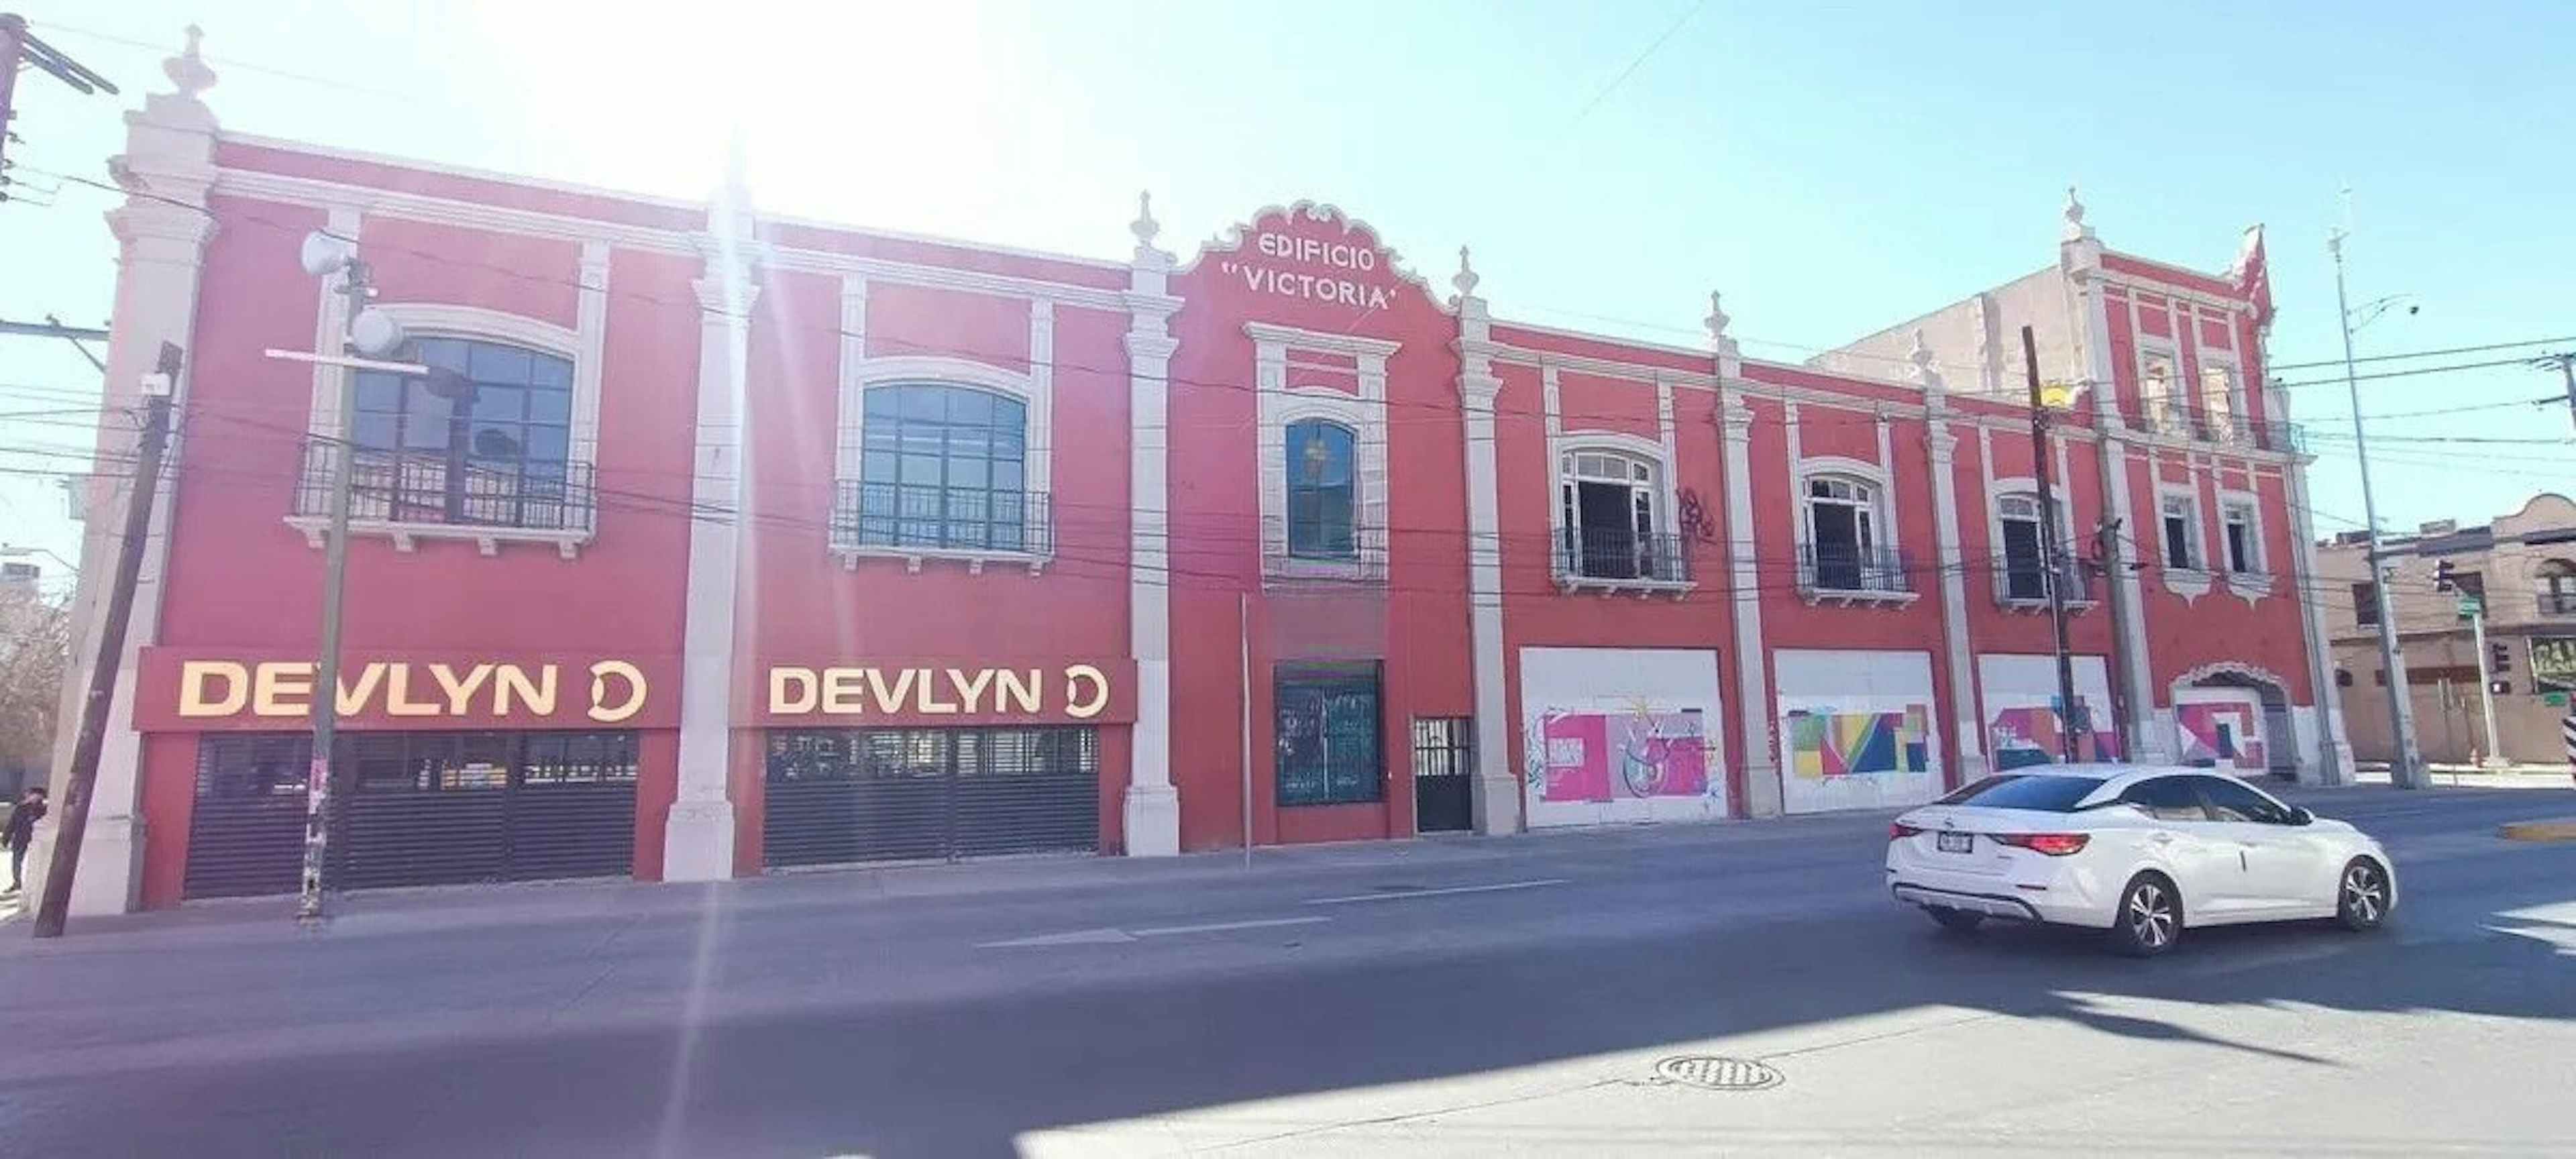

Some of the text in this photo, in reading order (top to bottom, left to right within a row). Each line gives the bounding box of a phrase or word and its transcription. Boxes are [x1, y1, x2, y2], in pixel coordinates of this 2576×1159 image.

[1259, 233, 1375, 272] EDIFICIO
[179, 661, 556, 716] DEVLYN
[769, 667, 1041, 714] DEVLYN
